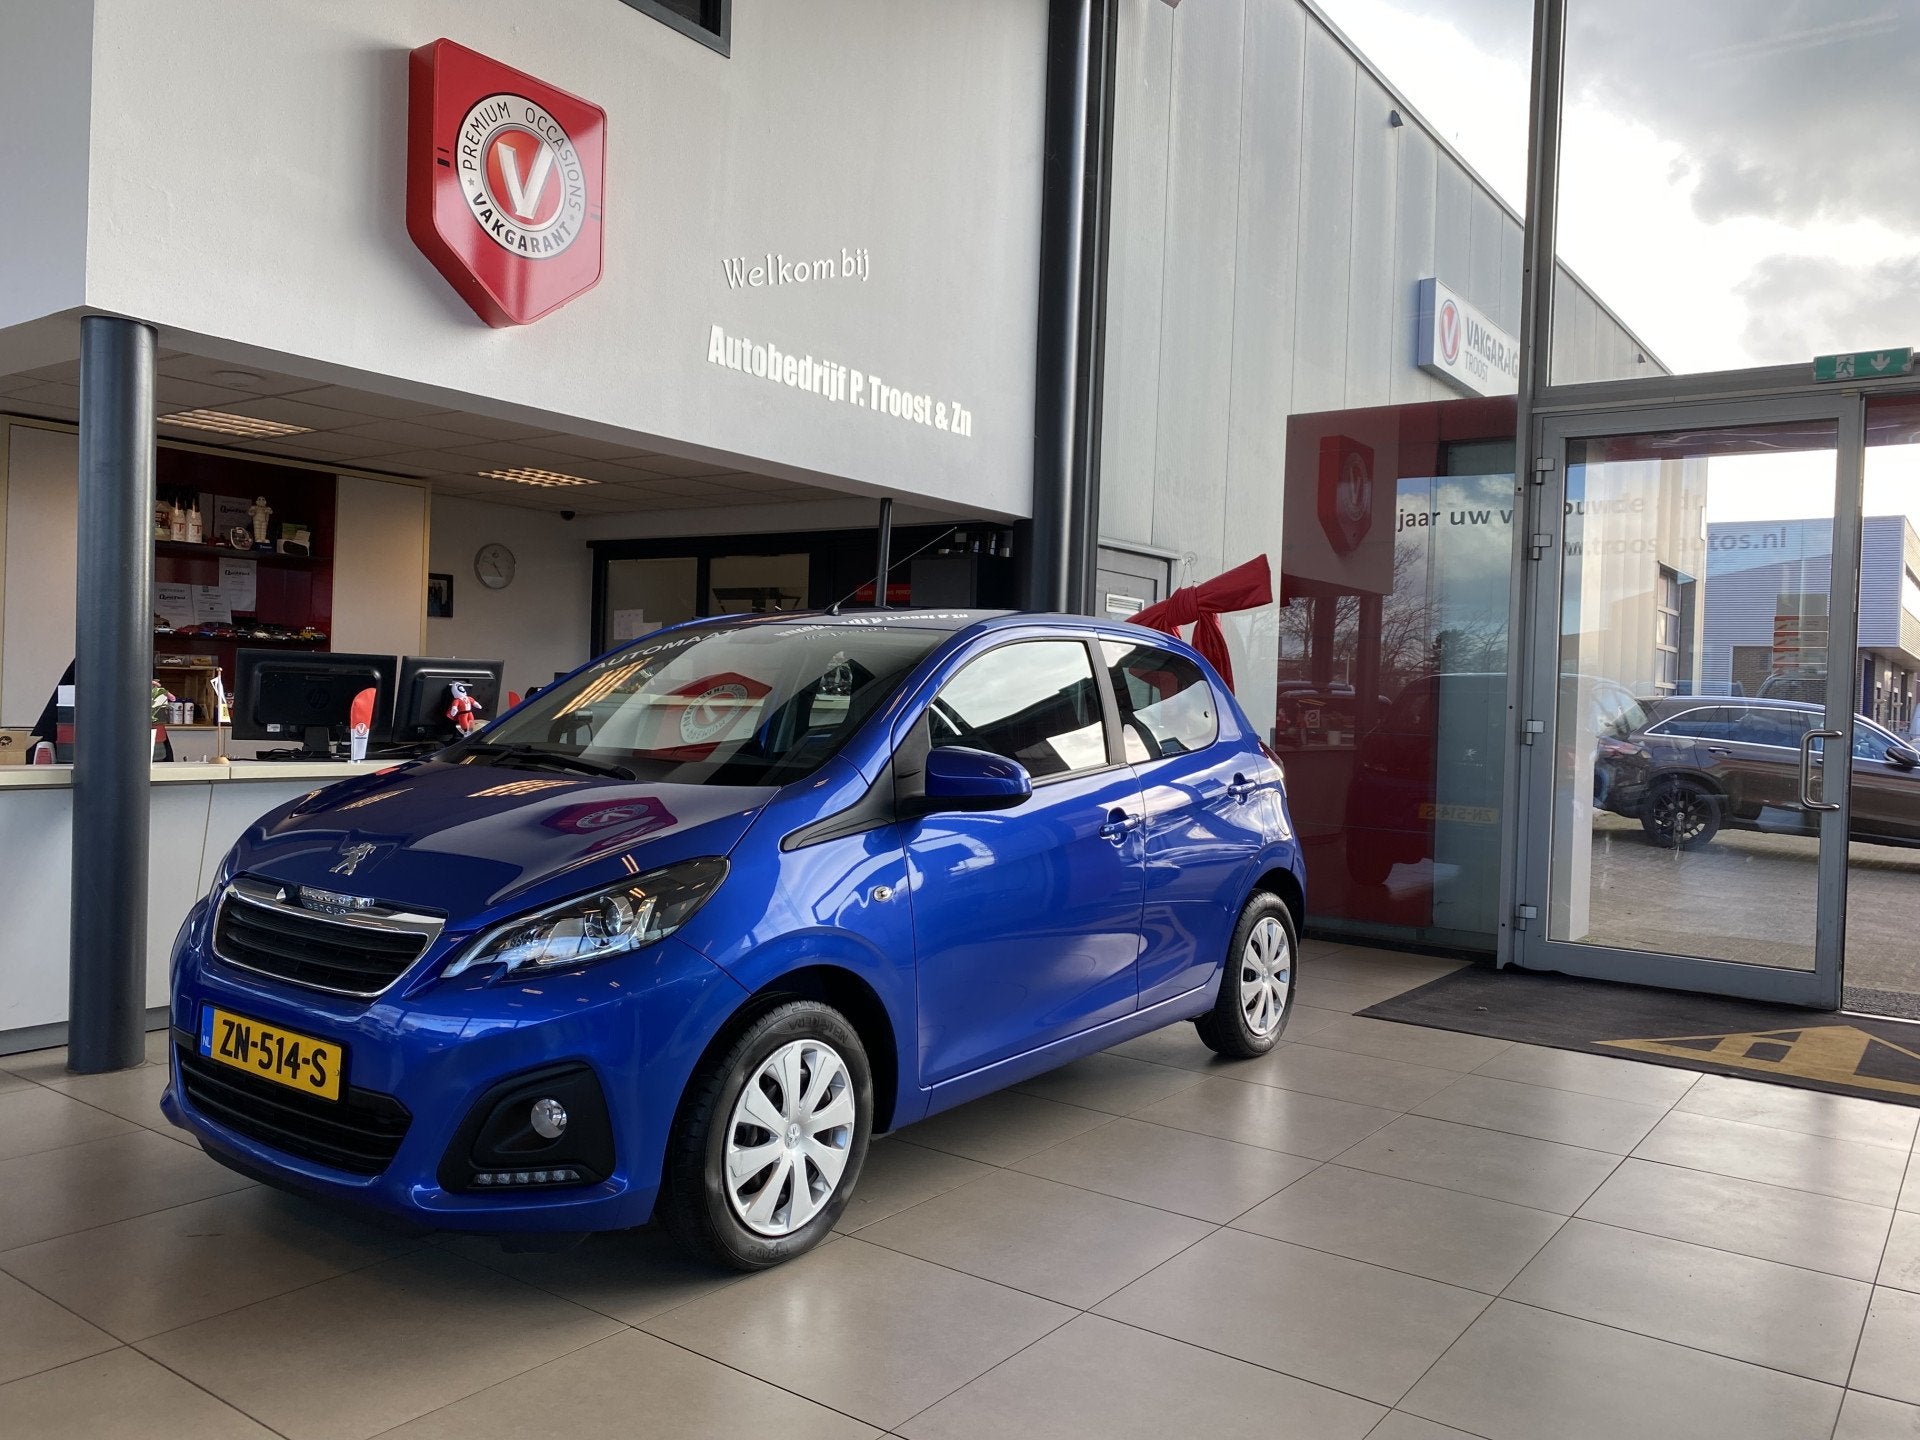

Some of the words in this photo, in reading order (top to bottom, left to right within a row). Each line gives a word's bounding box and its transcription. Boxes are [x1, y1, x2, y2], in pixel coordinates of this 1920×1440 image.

[462, 101, 512, 172] PREMIUM
[525, 107, 582, 212] OCCASIONS
[472, 192, 572, 253] VAKGARANT
[722, 253, 836, 290] Welkom
[841, 248, 870, 282] bij
[707, 324, 846, 402] Autobedrijf
[850, 368, 865, 407] P.
[868, 374, 932, 427] Troost
[934, 401, 949, 431] &
[951, 401, 972, 437] Zn
[1465, 350, 1489, 383] TROOST
[1397, 508, 1441, 533] jaar
[1450, 509, 1491, 526] uw
[202, 1034, 211, 1048] NL
[219, 1018, 327, 1088] ZN-514-S
